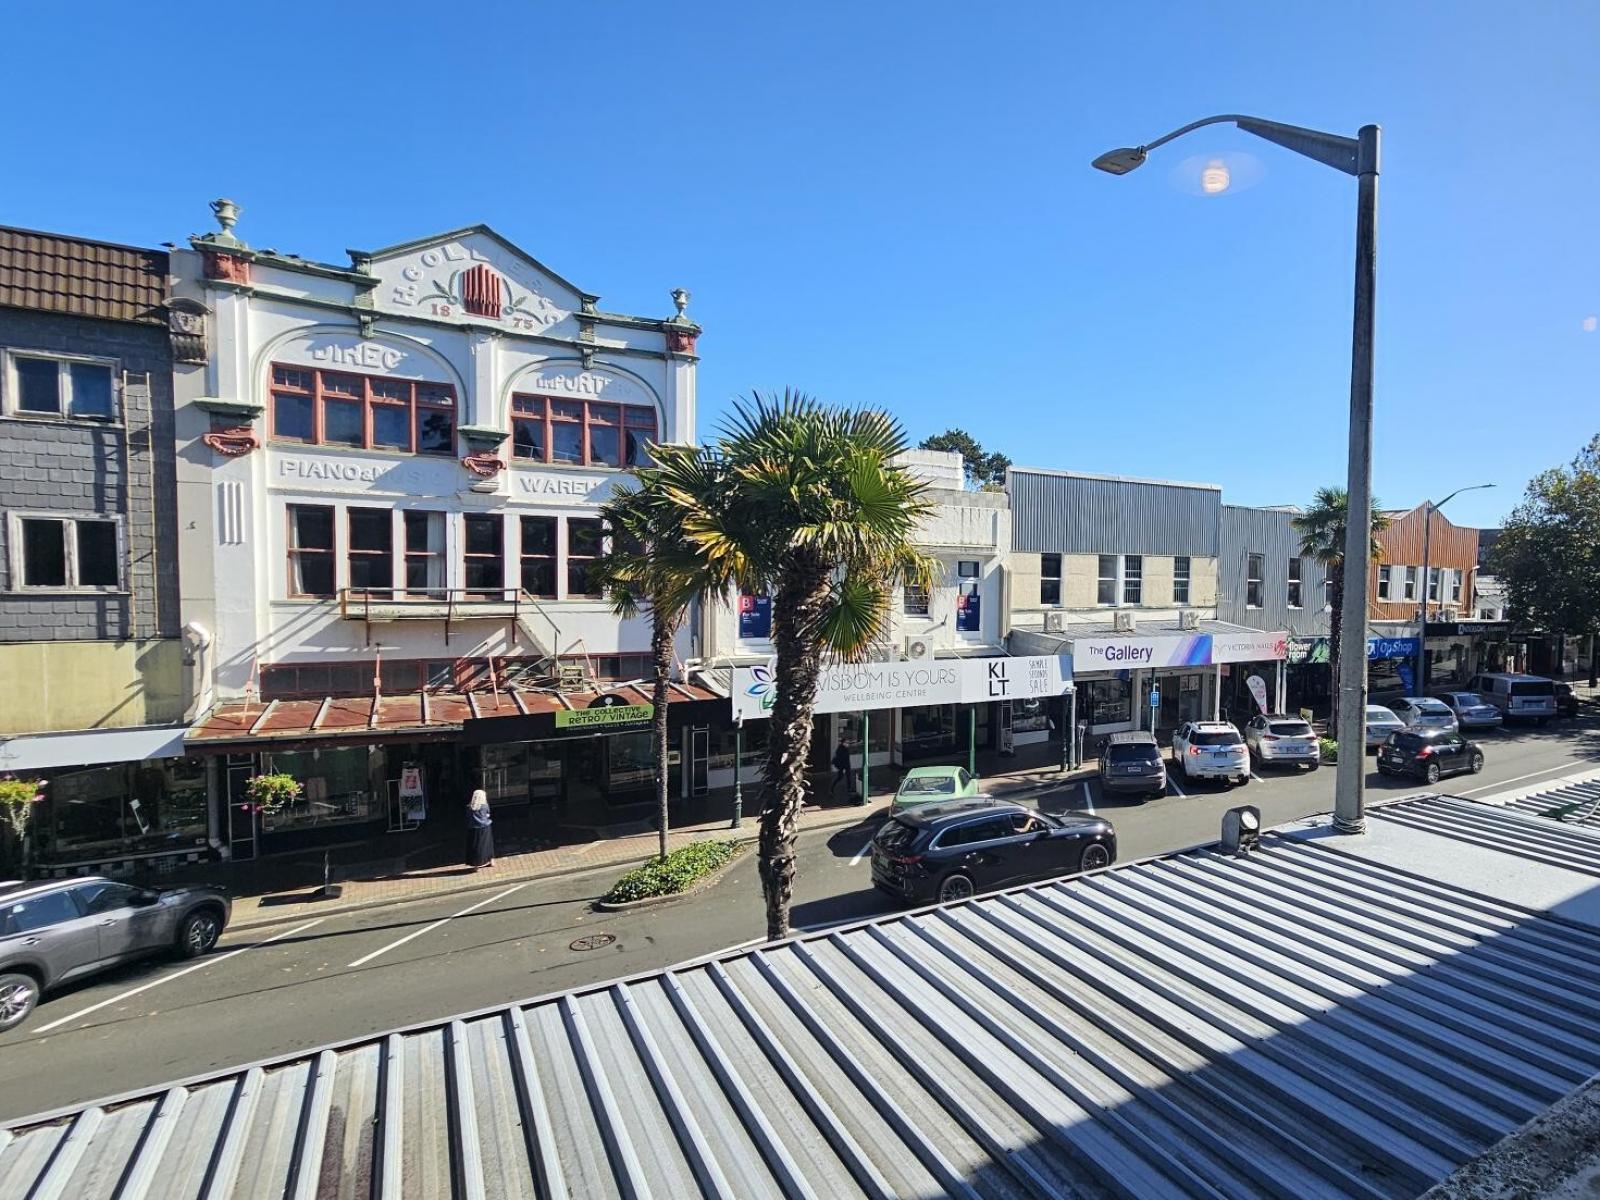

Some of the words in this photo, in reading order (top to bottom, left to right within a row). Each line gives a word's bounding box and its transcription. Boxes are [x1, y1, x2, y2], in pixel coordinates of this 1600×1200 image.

[431, 303, 450, 317] 18
[513, 317, 534, 329] 75
[313, 341, 414, 371] DIREC
[1289, 642, 1312, 651] flower
[1089, 646, 1104, 656] The
[1105, 645, 1153, 663] Gallery
[1289, 651, 1308, 659] room
[888, 671, 901, 688] IS
[905, 668, 957, 686] YOURS
[1029, 679, 1048, 694] SALE
[844, 691, 892, 702] WELLBEING
[896, 689, 927, 699] CENTRE
